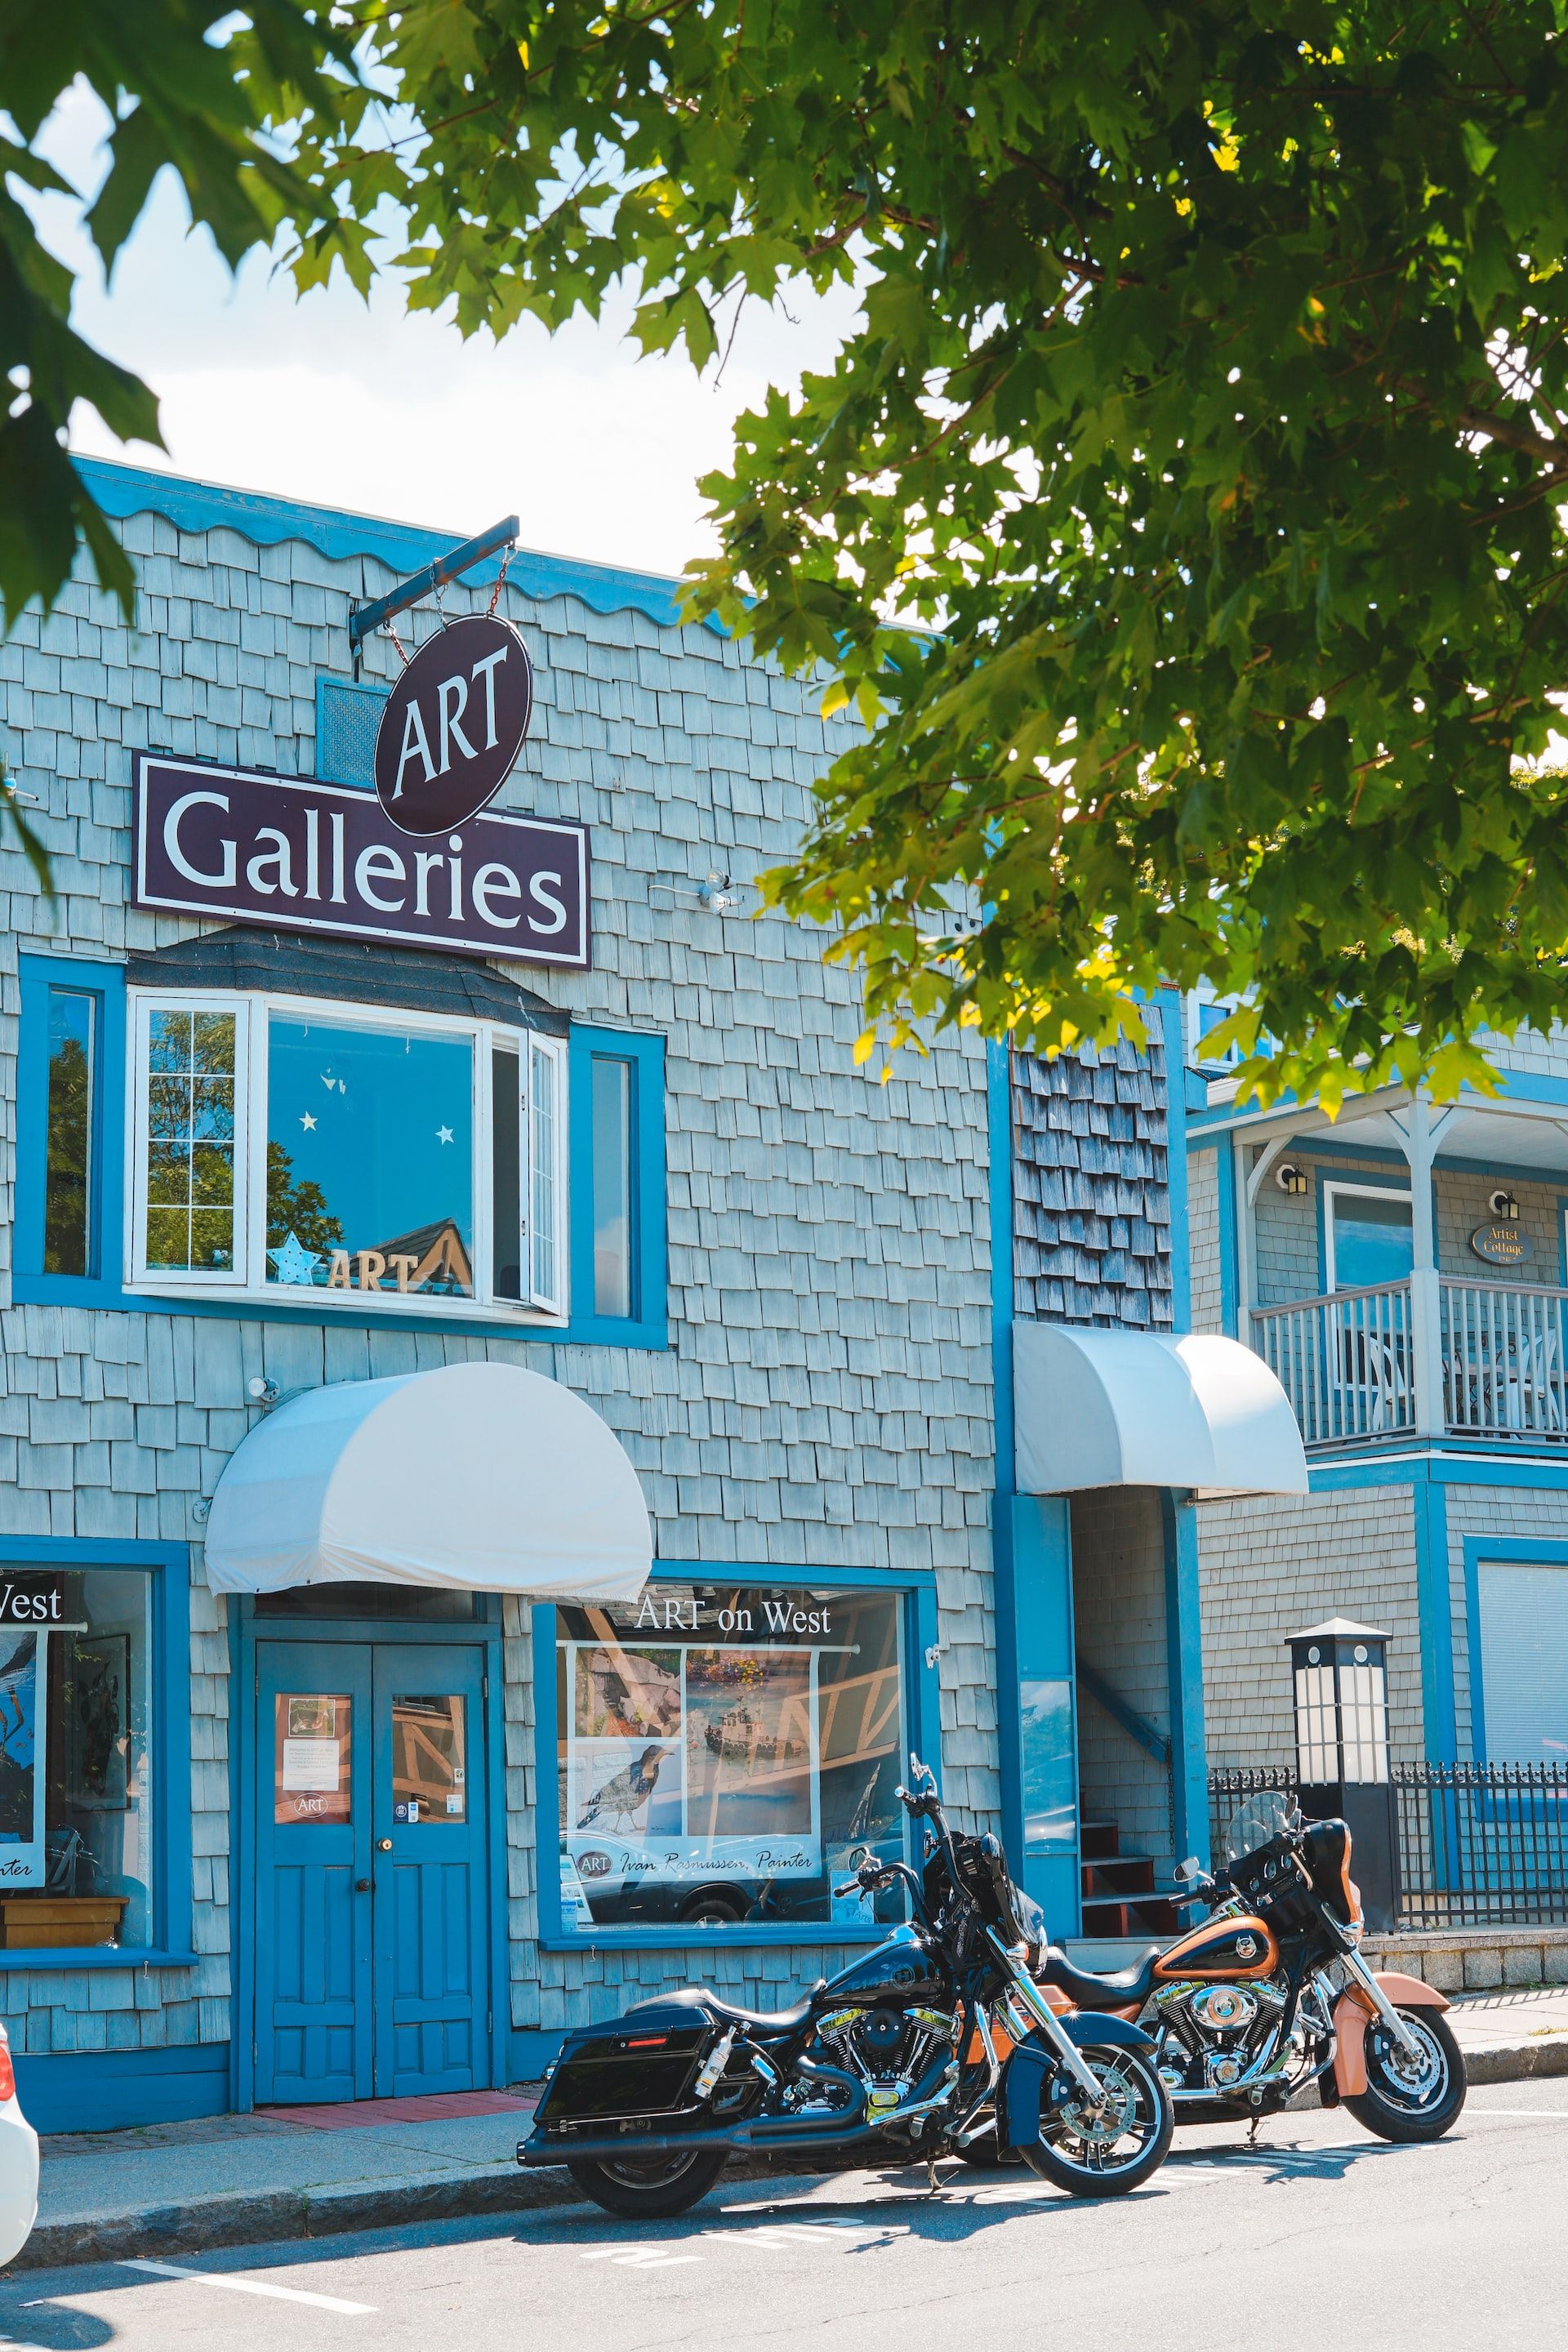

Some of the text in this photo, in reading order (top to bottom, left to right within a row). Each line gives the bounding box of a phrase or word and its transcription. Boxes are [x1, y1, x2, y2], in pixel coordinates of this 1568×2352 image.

[390, 645, 509, 801] ART
[163, 791, 568, 935] Galleries
[1488, 1227, 1518, 1241] Artist
[1483, 1240, 1524, 1256] Cottage
[327, 1249, 419, 1294] ART
[633, 1593, 832, 1633] ART on West
[297, 1798, 324, 1811] ART
[581, 1857, 608, 1871] ART
[620, 1852, 657, 1873] Ivan
[755, 1850, 813, 1869] Painter
